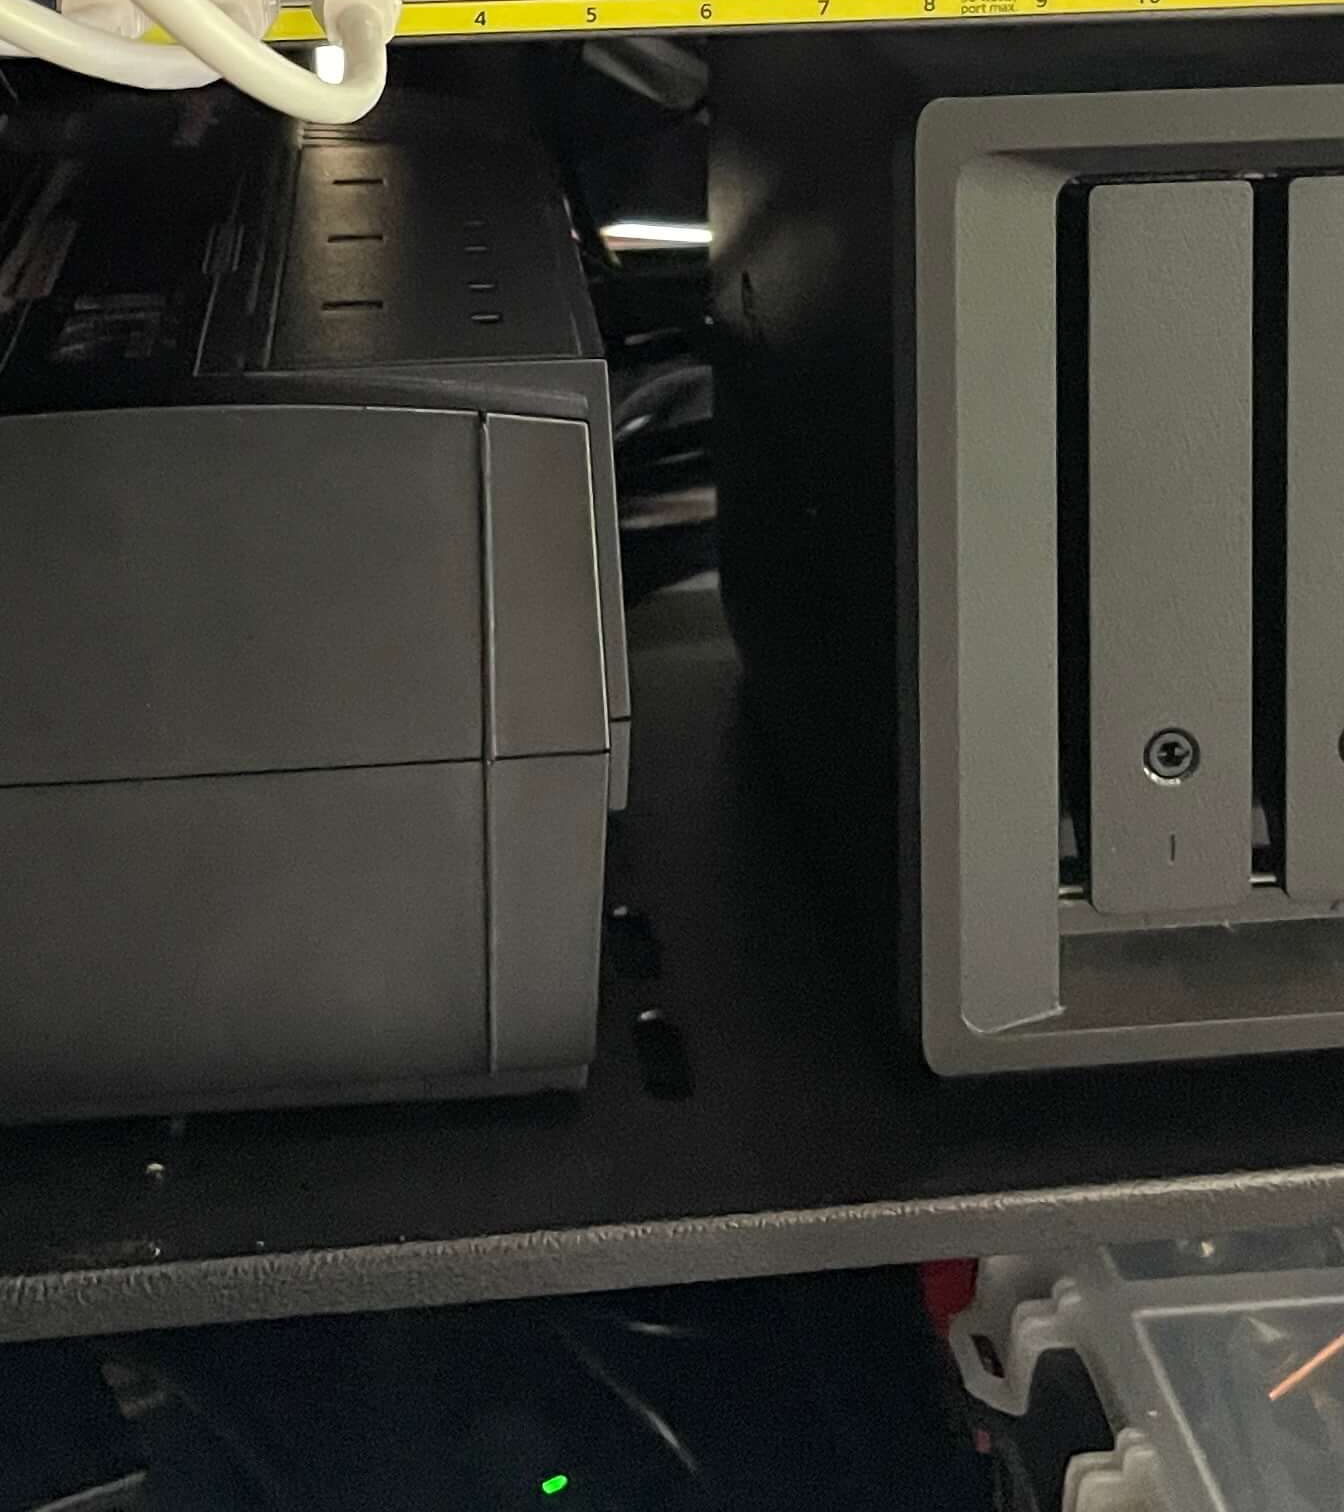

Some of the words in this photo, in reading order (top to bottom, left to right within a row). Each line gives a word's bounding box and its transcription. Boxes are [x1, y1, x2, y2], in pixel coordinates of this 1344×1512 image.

[586, 7, 597, 23] 5
[700, 3, 712, 19] 6
[817, 0, 830, 16] 7
[960, 3, 987, 15] port
[474, 10, 487, 26] 4
